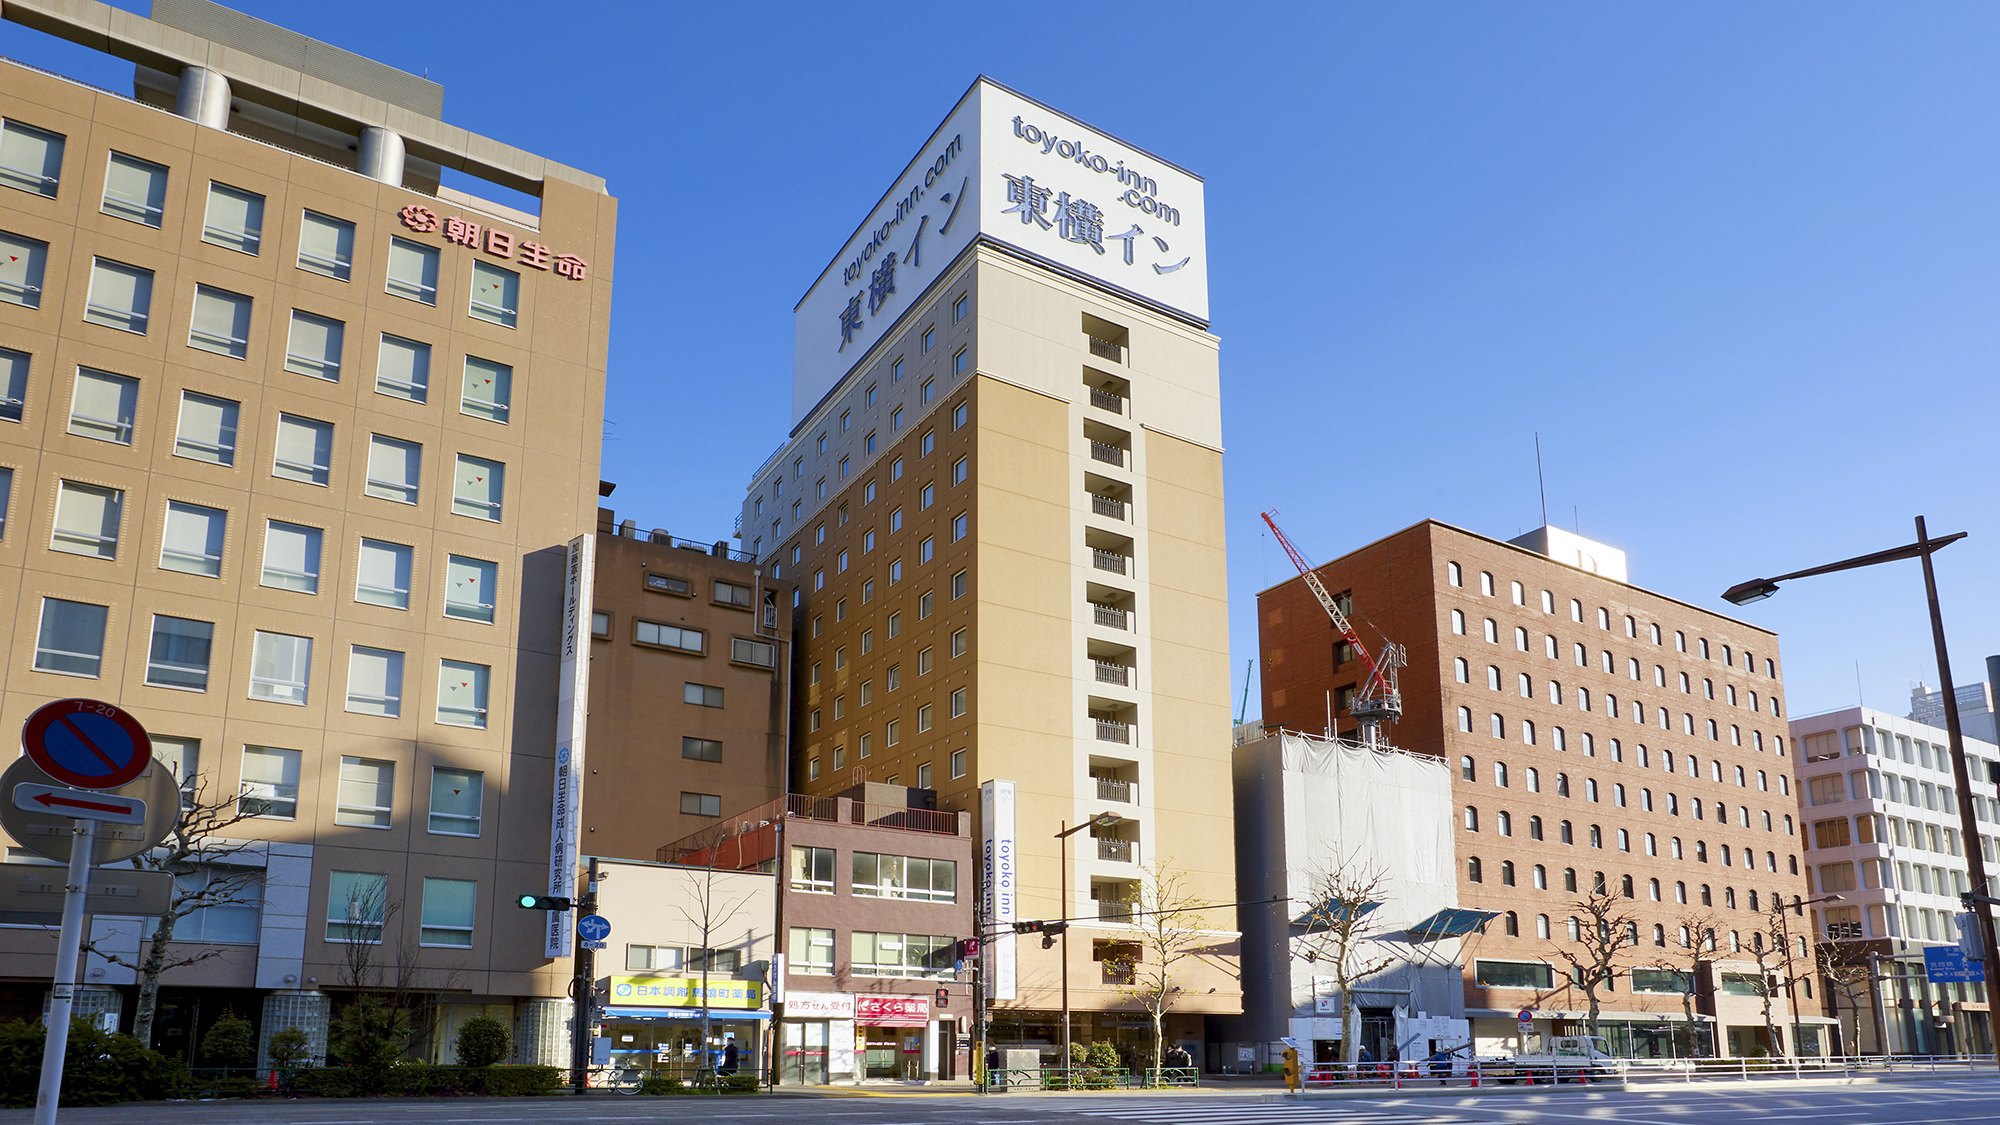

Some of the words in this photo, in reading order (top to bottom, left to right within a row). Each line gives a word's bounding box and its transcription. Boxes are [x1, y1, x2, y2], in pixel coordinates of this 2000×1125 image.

[1012, 114, 1158, 198] toyoko-inn
[843, 132, 963, 288] toyoko-inn.com
[1000, 172, 1191, 276] 東横イン
[1117, 188, 1182, 227] .com
[445, 215, 588, 281] 朝日生命
[837, 175, 970, 354] 東横イン
[75, 701, 116, 718] 7-20
[549, 764, 568, 950] 朝日生命成人病研究所属医院
[984, 839, 993, 888] toyoko
[999, 839, 1013, 888] toyoko
[985, 892, 993, 915] inn
[1001, 893, 1013, 915] inn
[788, 1000, 851, 1010] 処方せん受付
[870, 1001, 928, 1013] さくら薬局
